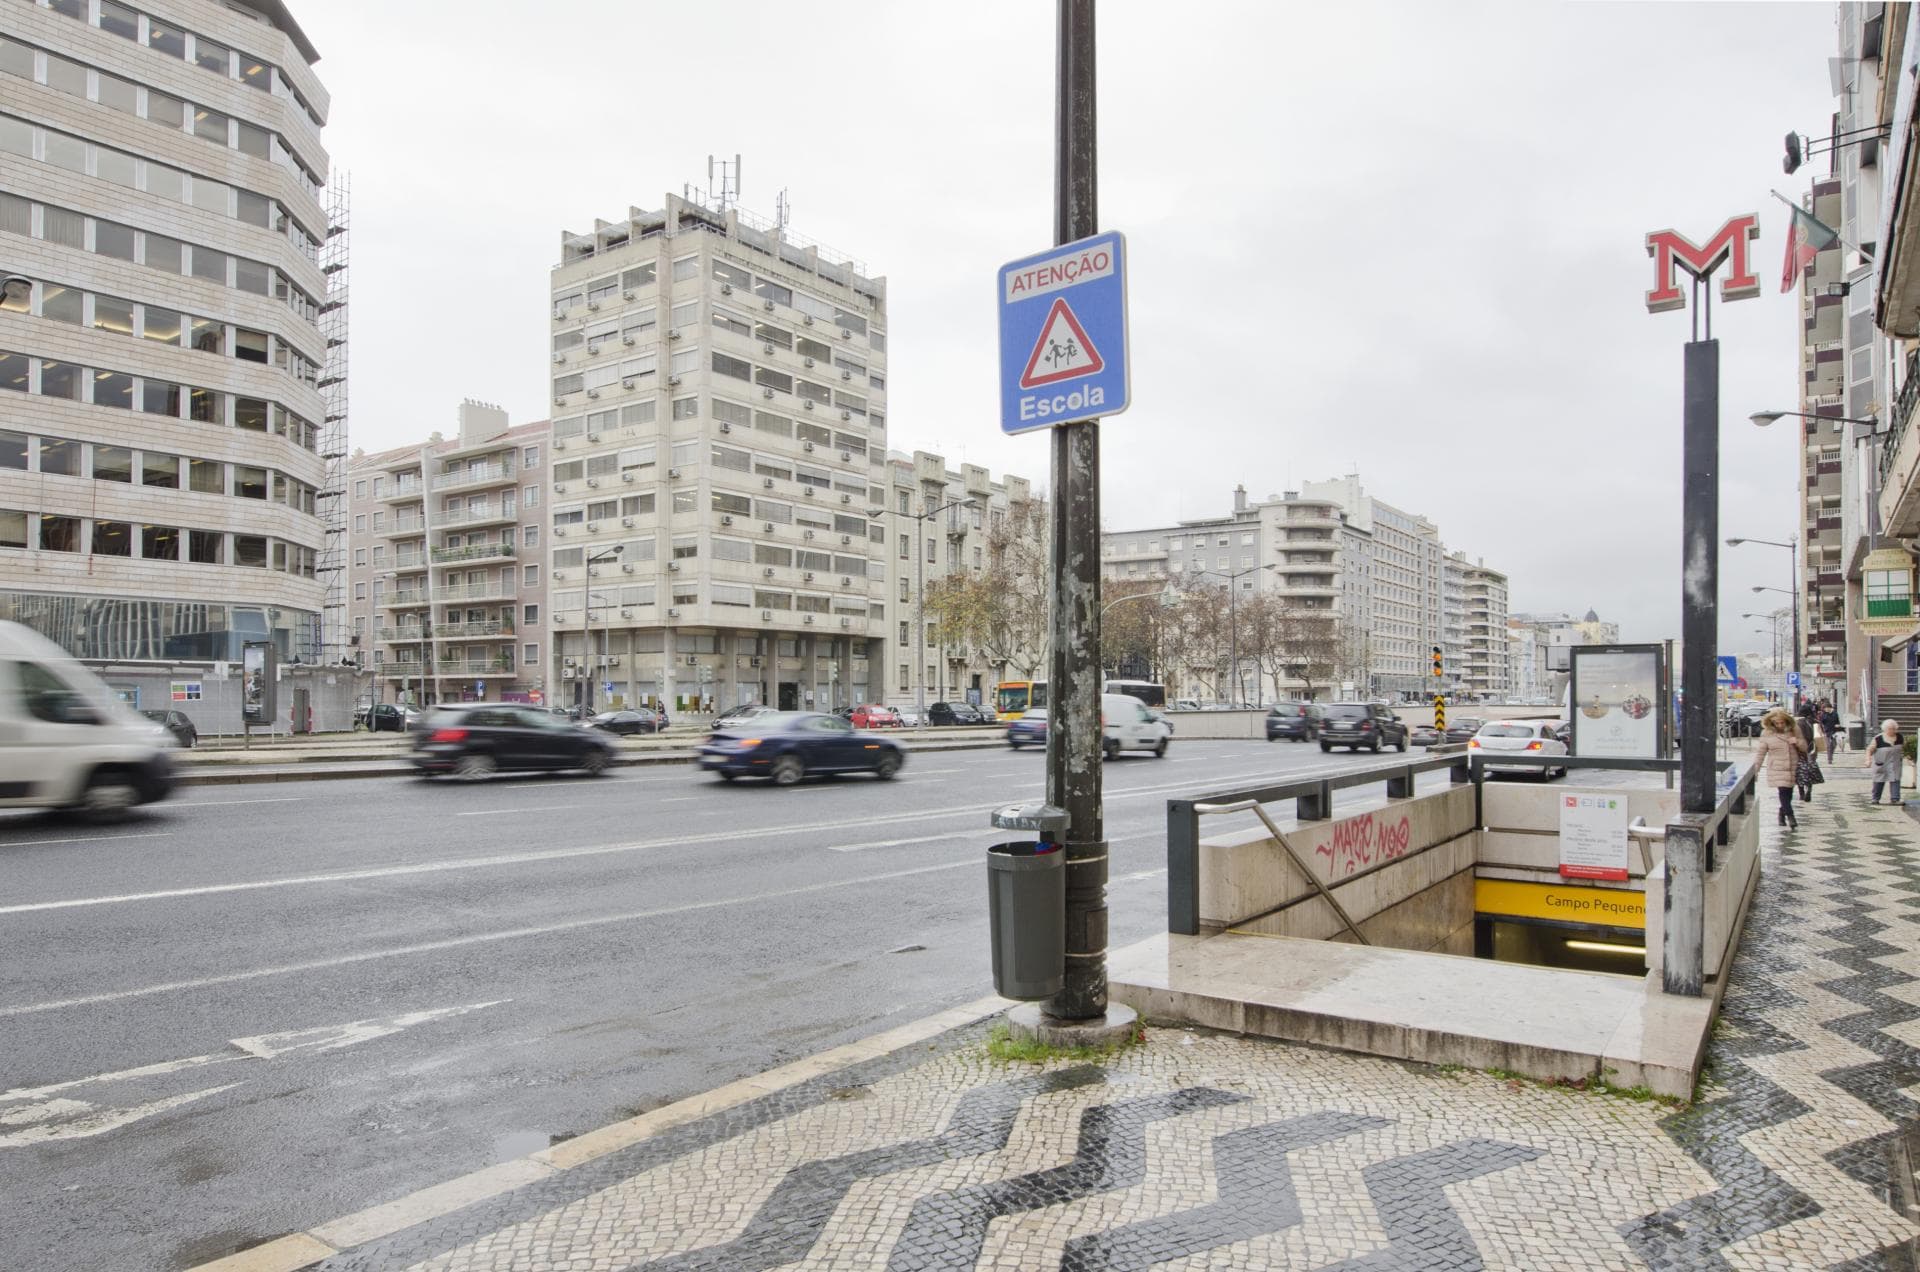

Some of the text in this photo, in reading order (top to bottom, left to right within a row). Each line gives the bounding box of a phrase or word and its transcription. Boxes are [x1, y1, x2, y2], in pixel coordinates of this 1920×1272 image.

[1011, 252, 1109, 294] ATENÇÃO
[1646, 212, 1760, 306] M
[1019, 384, 1105, 421] Escola
[1789, 673, 1798, 684] P
[1545, 894, 1591, 911] Campo
